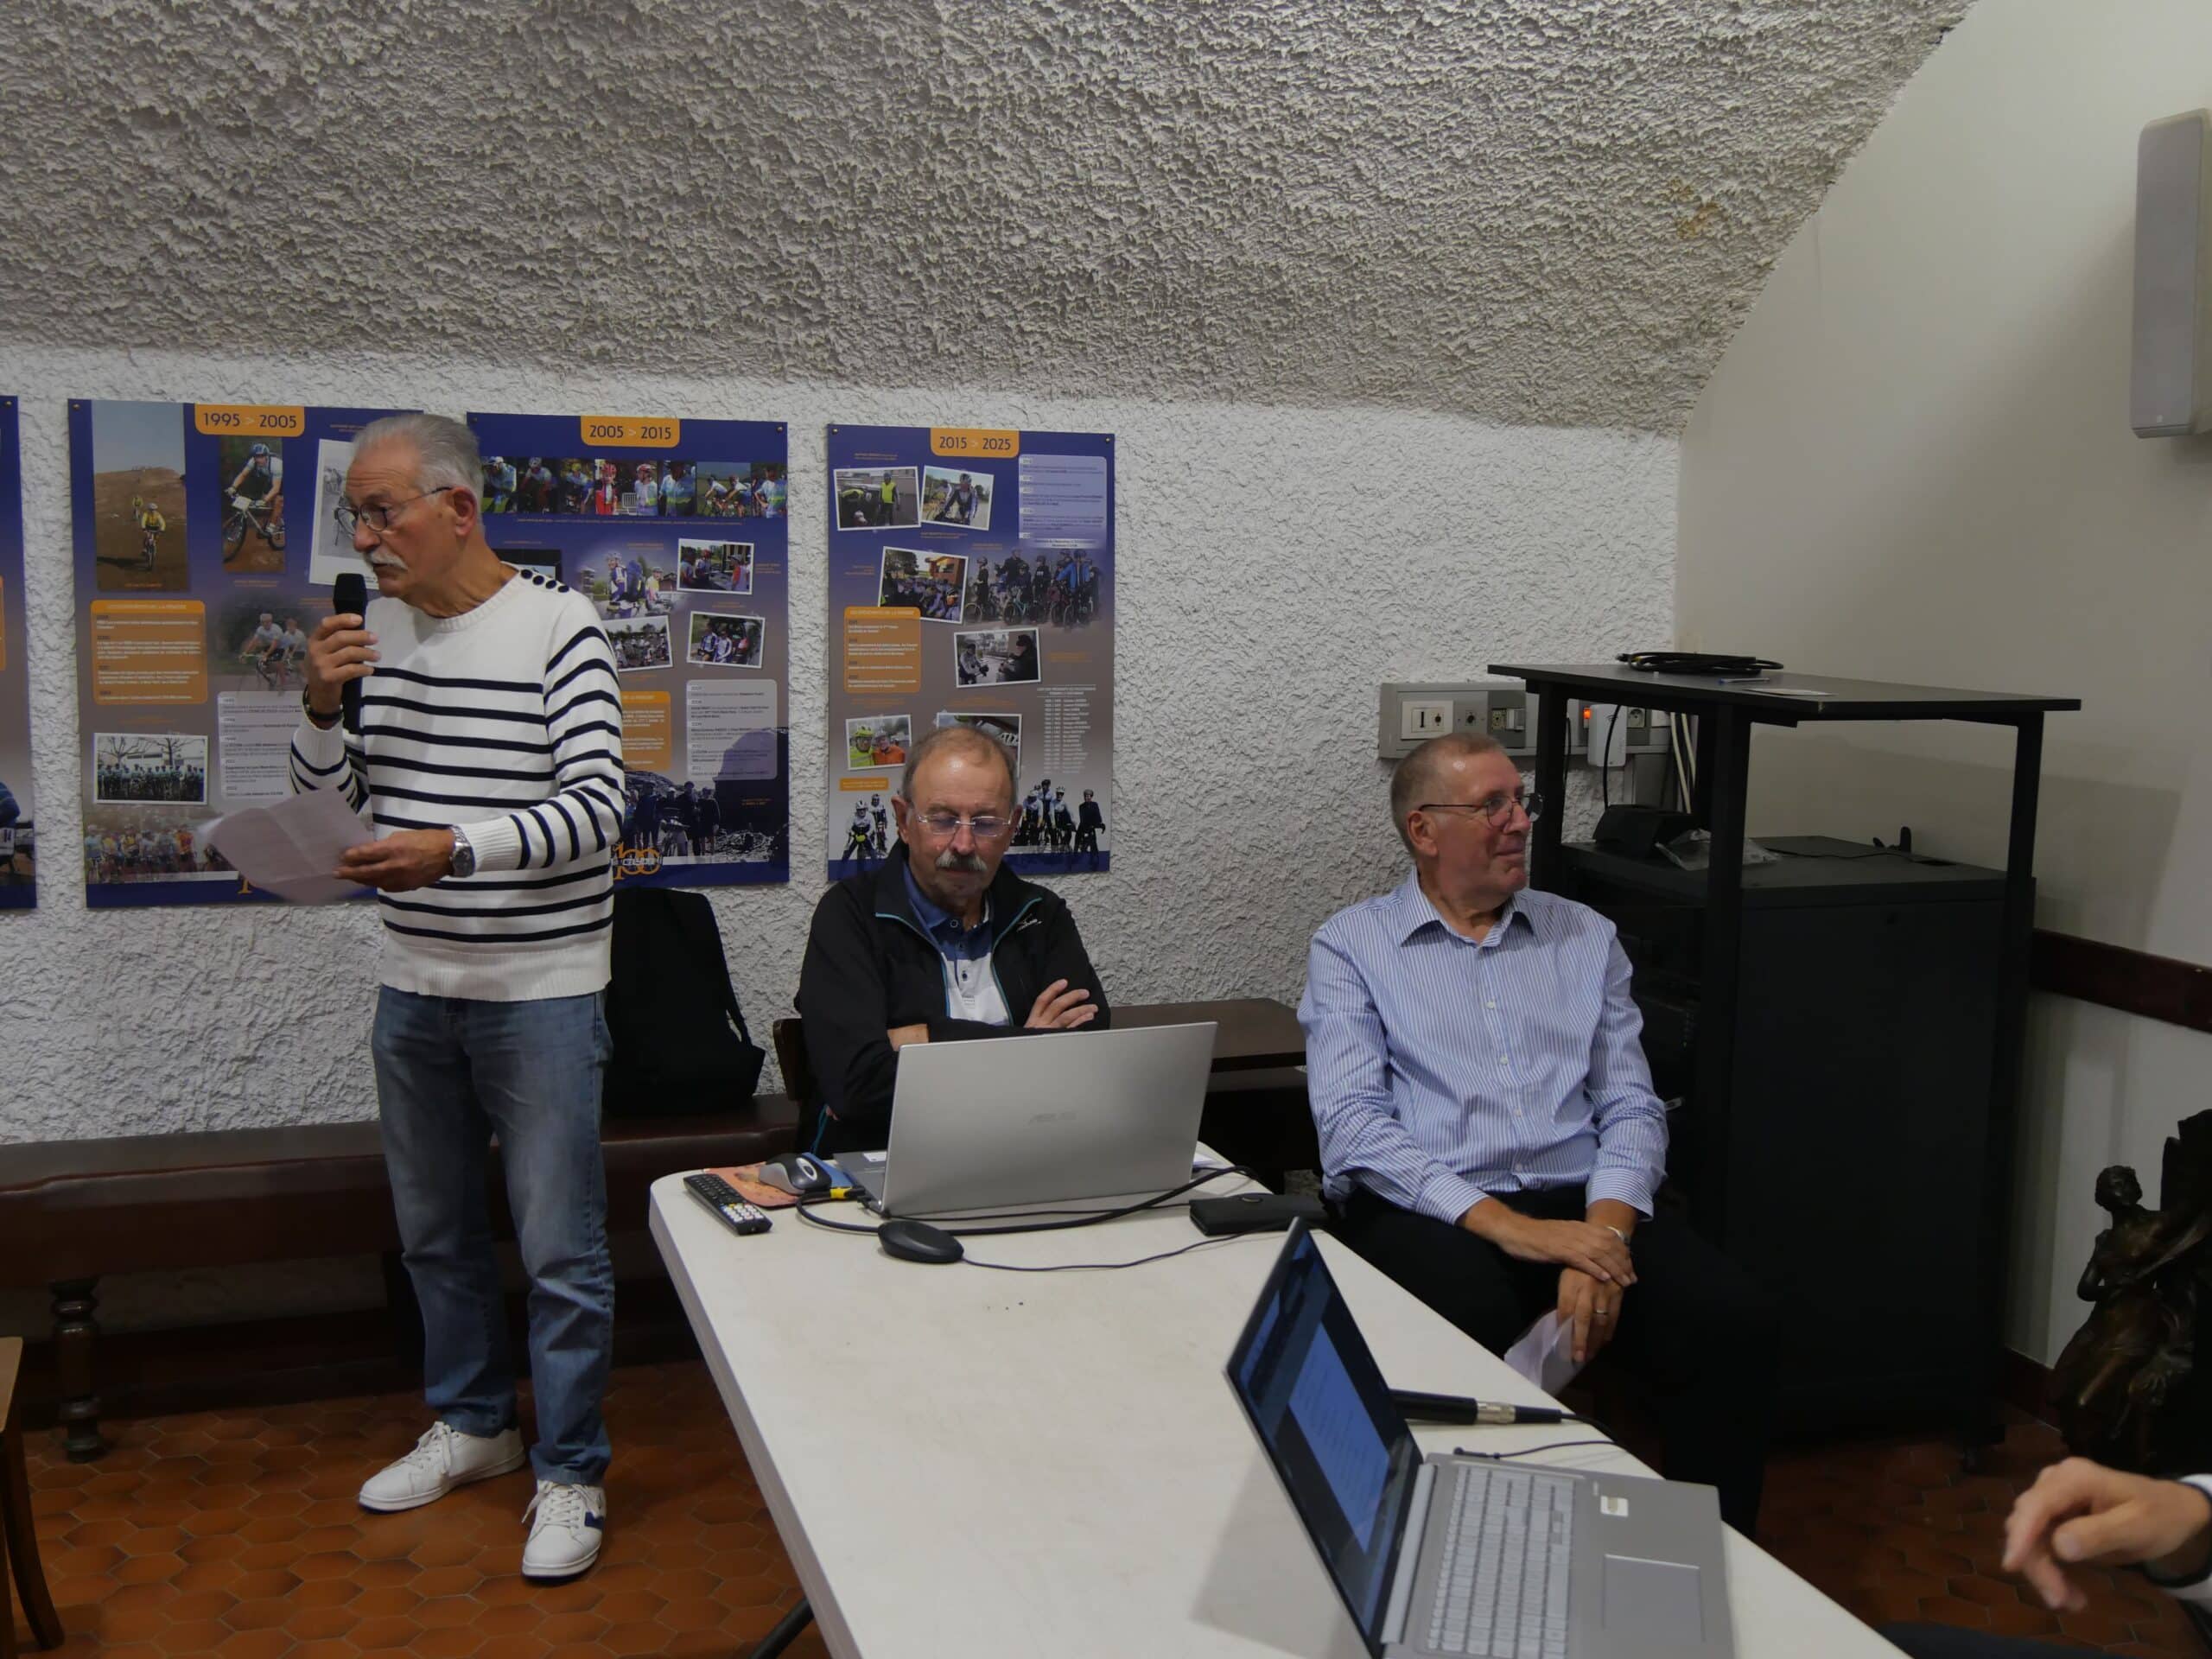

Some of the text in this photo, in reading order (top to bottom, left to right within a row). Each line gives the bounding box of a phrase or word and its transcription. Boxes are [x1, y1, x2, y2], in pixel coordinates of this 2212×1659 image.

[204, 413, 297, 428] 1995 2005
[589, 425, 671, 439] 2005 2015
[939, 435, 1011, 450] 2015 2025
